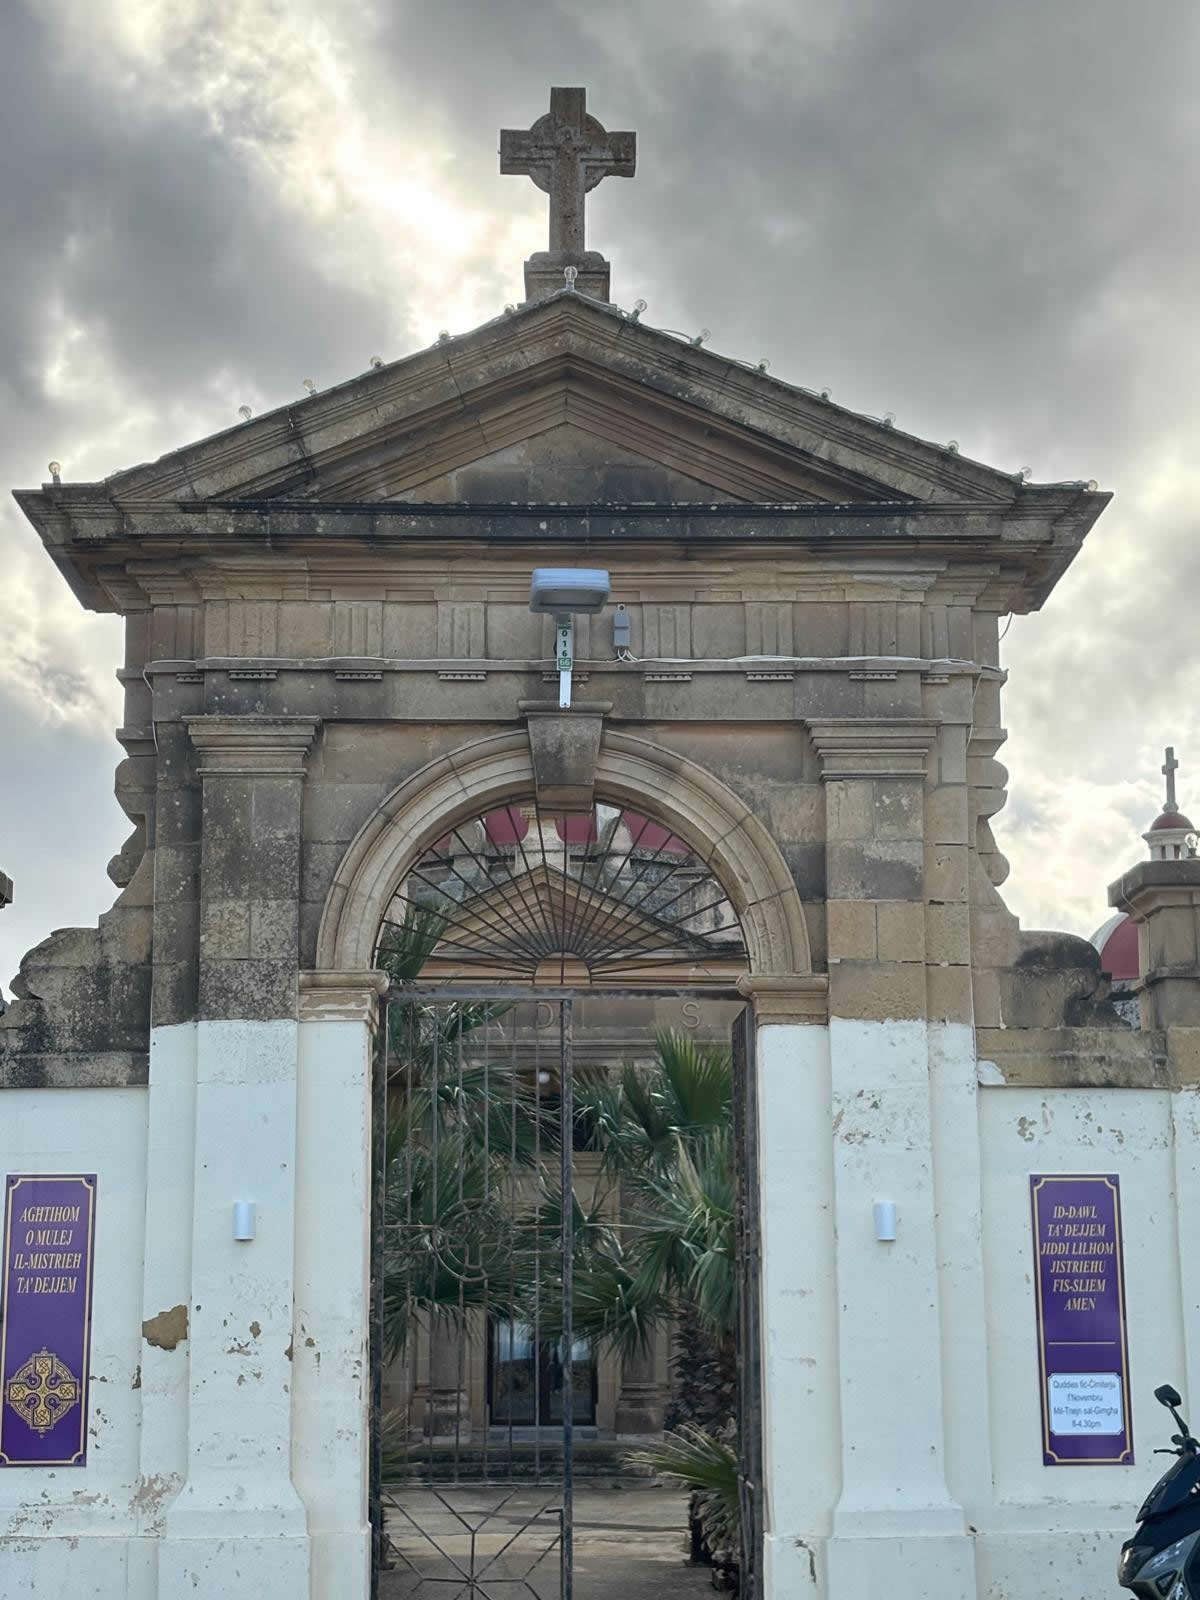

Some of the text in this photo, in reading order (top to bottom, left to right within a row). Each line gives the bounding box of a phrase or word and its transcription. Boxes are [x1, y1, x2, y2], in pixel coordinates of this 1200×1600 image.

[682, 1001, 700, 1029] S
[1053, 1205, 1097, 1219] ID-DAWL
[1064, 1223, 1106, 1237] DEJJEM
[25, 1229, 73, 1246] O MULEJ
[1040, 1242, 1114, 1255] JIDDI LILHOM
[34, 1276, 77, 1293] DEJJEM
[1052, 1279, 1106, 1292] FIS-SLIEM
[1064, 1298, 1096, 1311] AMEN
